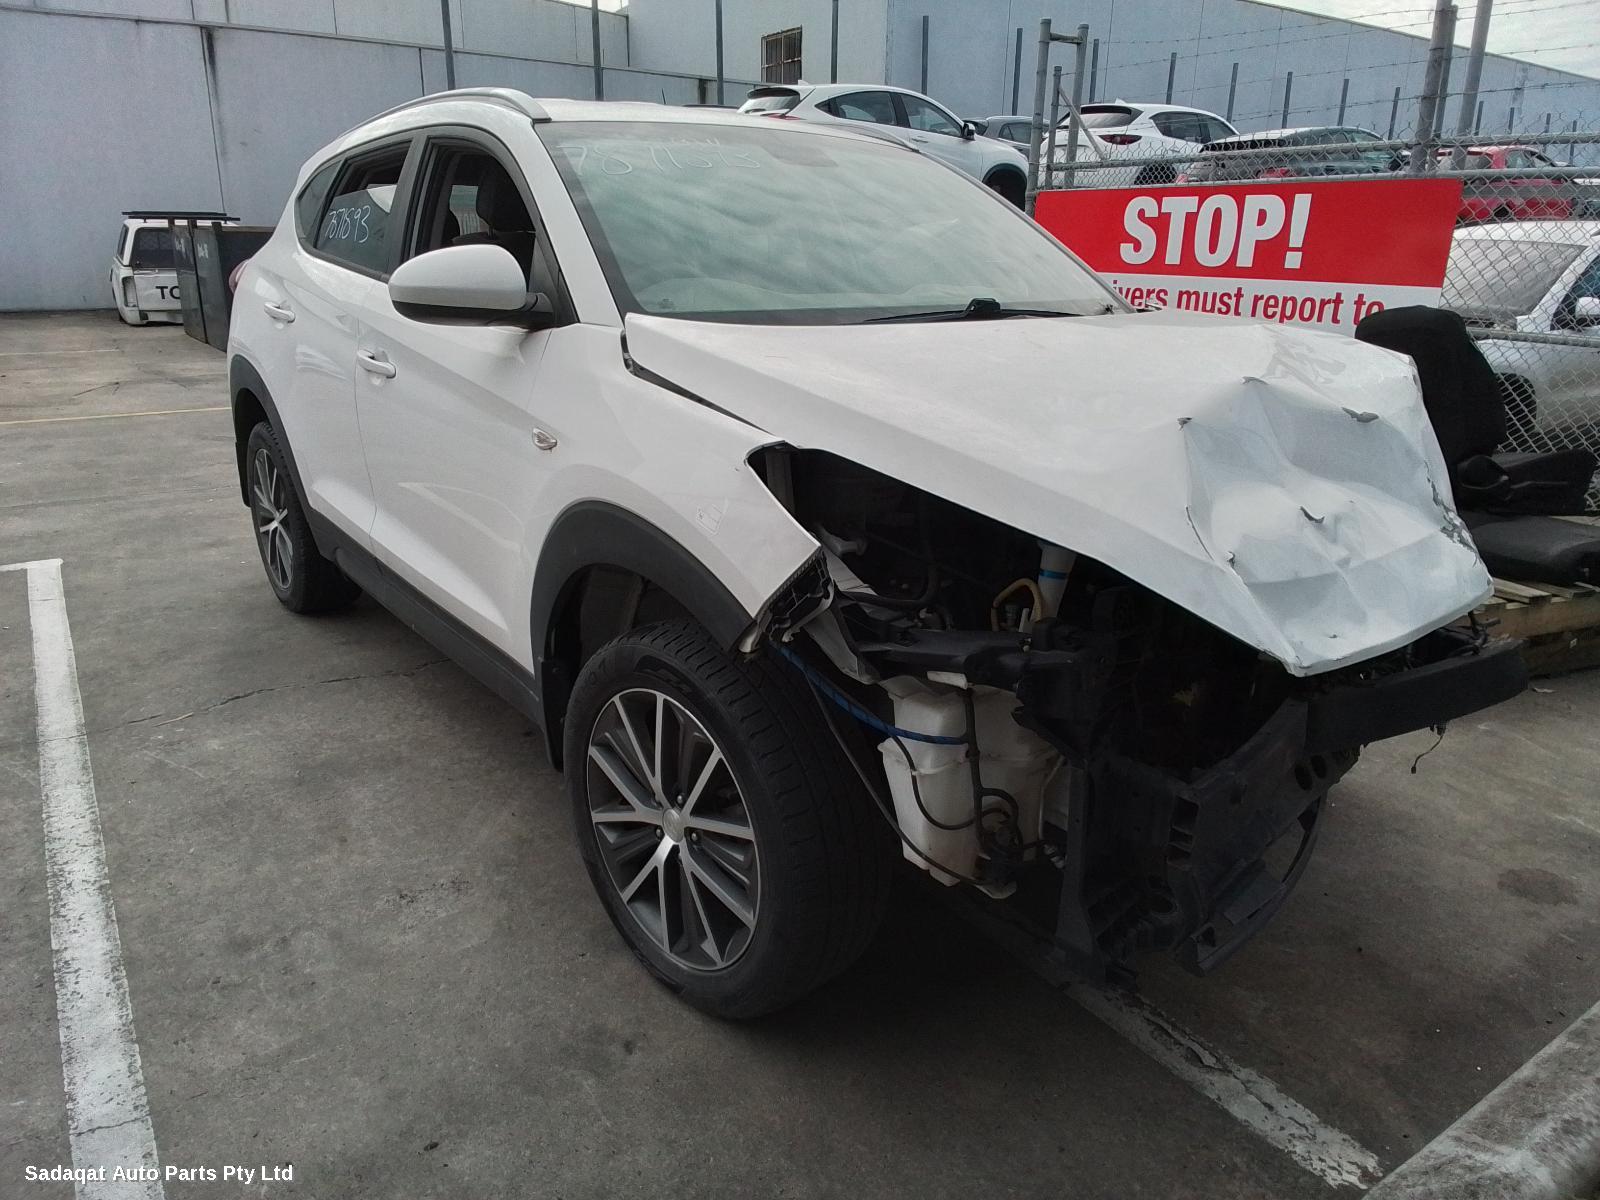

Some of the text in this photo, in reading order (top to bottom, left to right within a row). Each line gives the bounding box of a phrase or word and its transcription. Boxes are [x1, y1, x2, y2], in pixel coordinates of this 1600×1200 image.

[1119, 193, 1312, 269] STOP!
[1176, 285, 1244, 317] must
[1250, 291, 1344, 325] report
